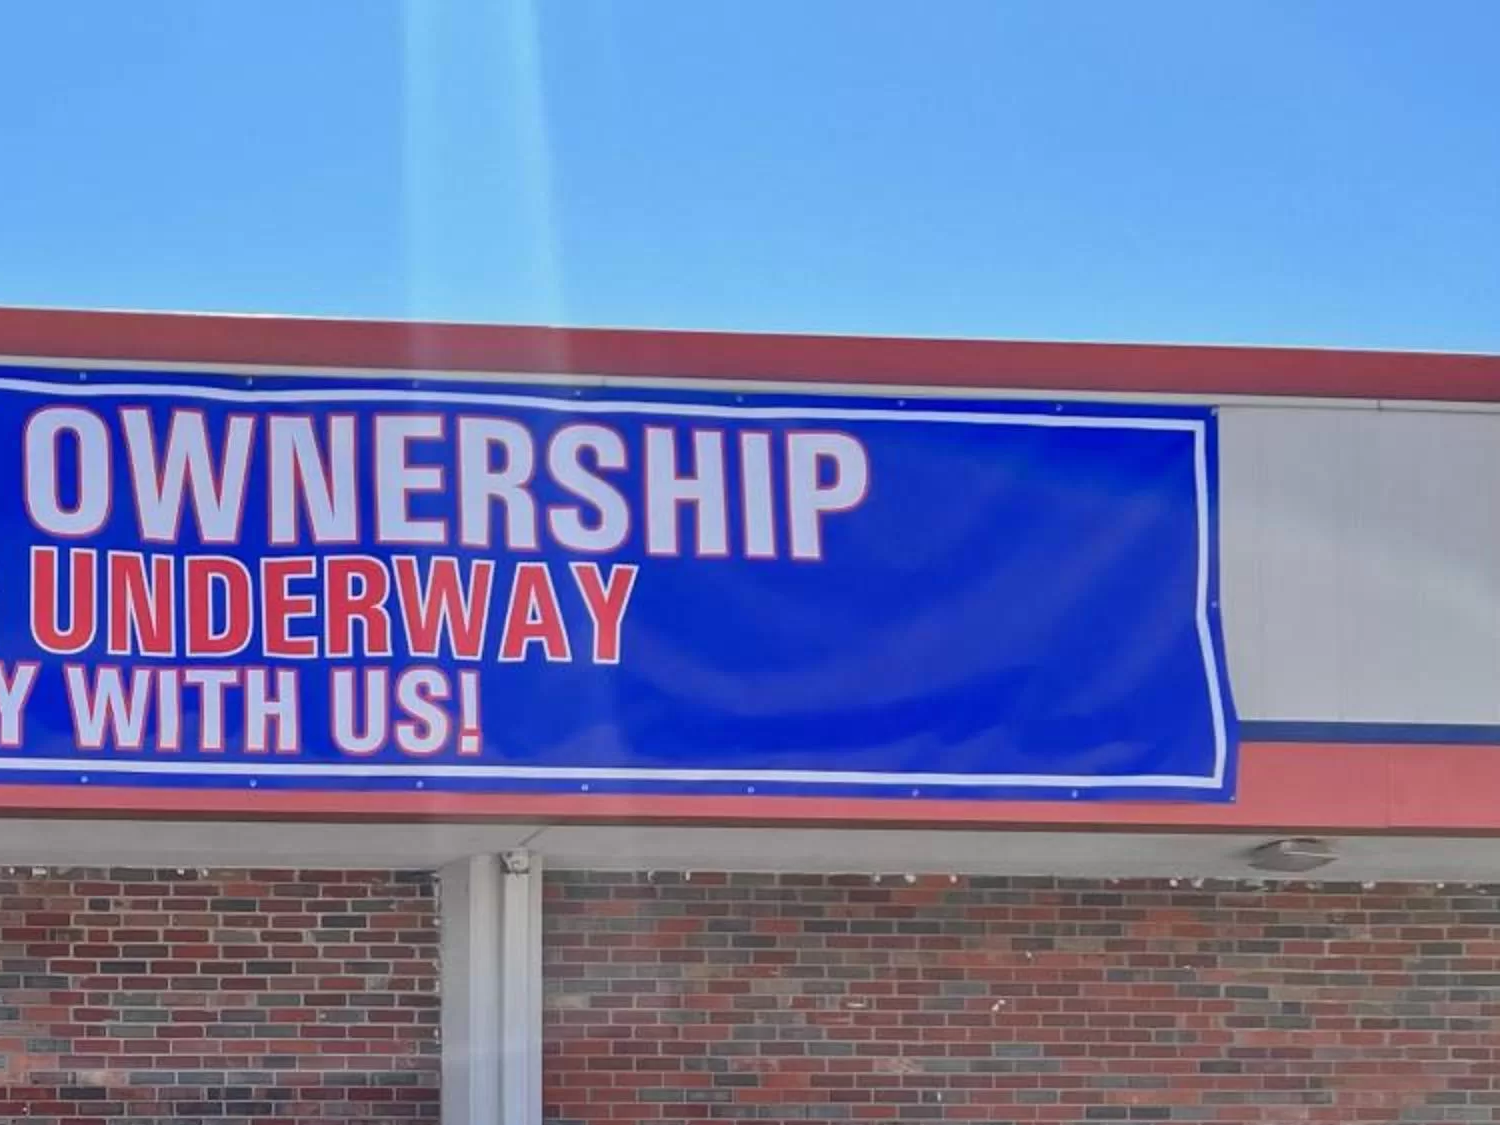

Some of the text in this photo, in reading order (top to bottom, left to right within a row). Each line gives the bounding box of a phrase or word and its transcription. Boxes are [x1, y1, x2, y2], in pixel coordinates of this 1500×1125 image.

[22, 406, 870, 562] OWNERSHIP
[28, 545, 640, 667] UNDERWAY
[64, 663, 300, 756] WITH
[330, 667, 483, 758] US!
